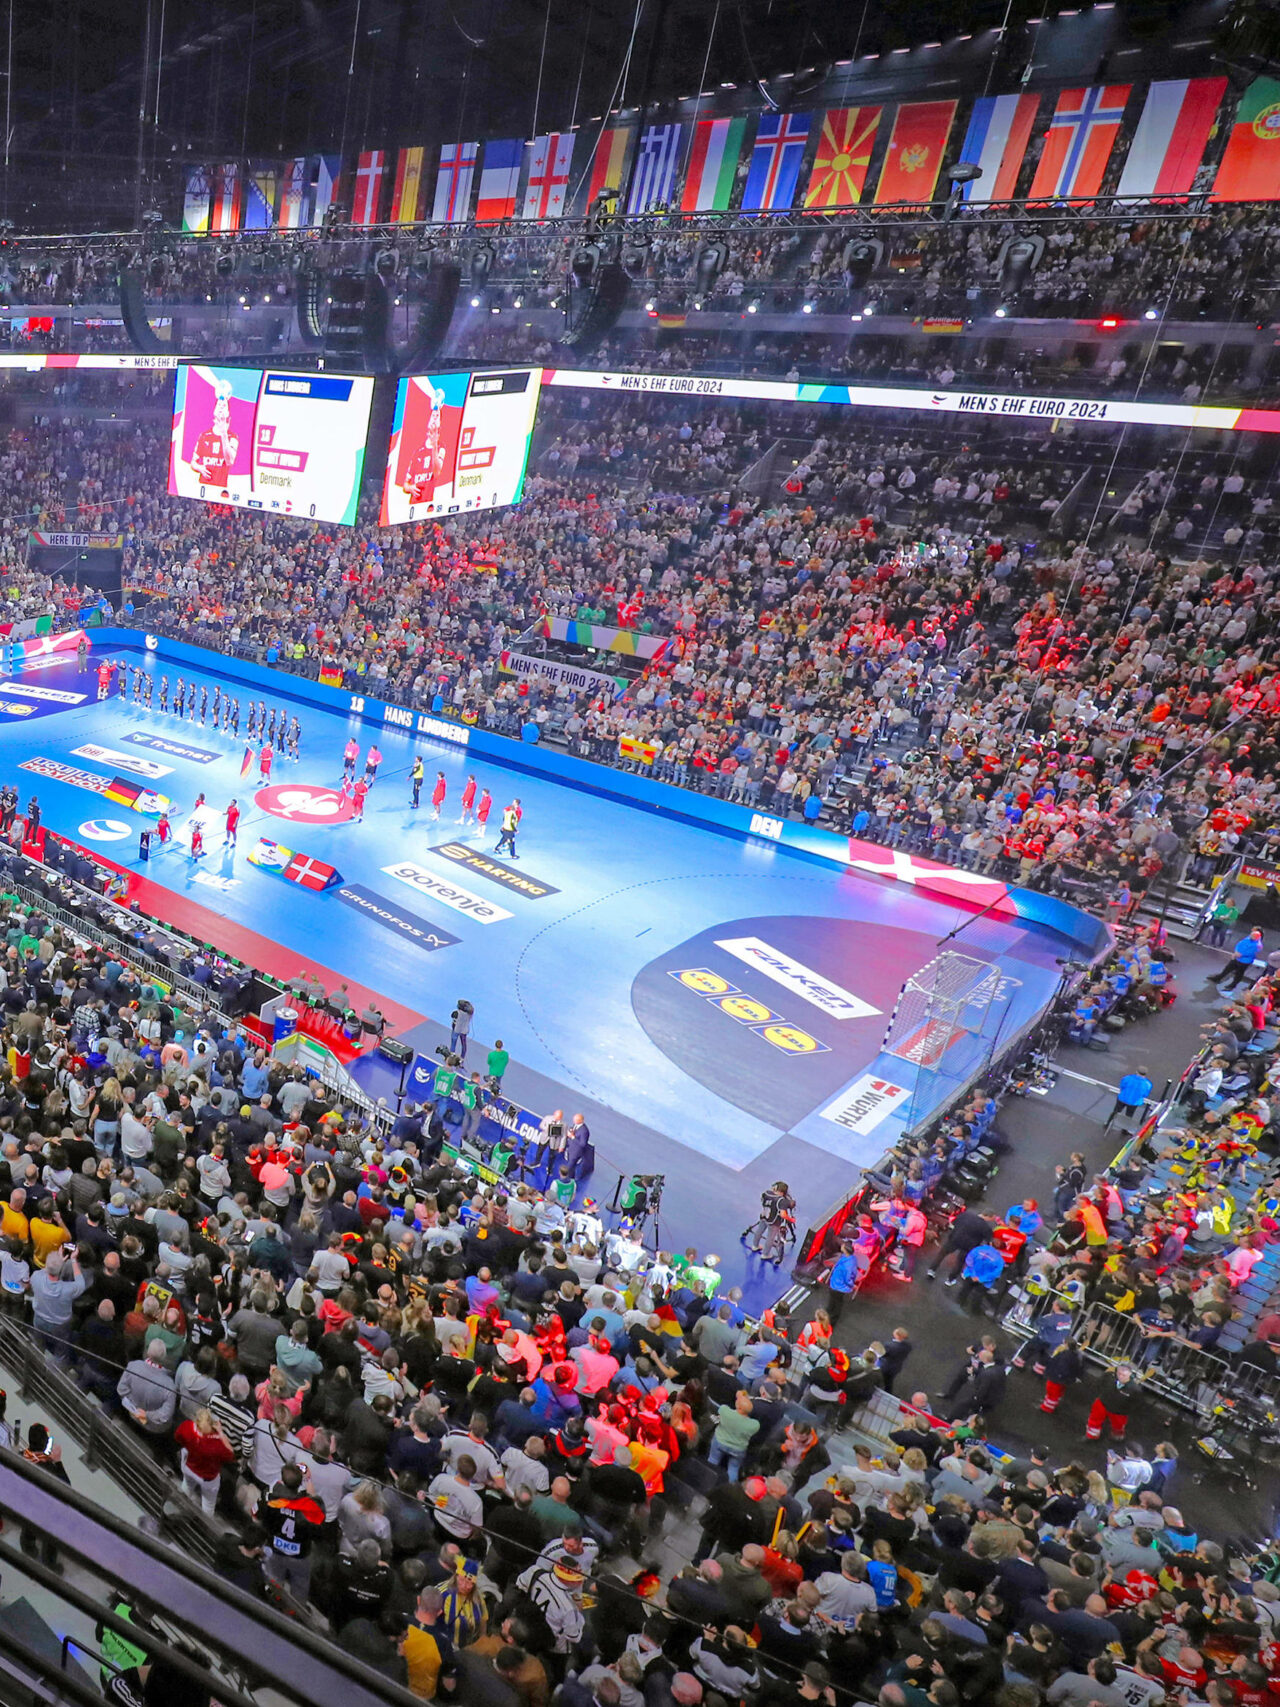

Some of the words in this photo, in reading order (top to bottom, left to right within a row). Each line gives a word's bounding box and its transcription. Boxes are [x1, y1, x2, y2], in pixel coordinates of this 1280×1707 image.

[157, 357, 170, 367] EHF
[650, 377, 667, 390] EHF
[669, 379, 694, 392] EURO
[696, 380, 723, 393] 2024
[1001, 398, 1026, 413] EHF
[1029, 400, 1065, 416] EURO
[1068, 402, 1108, 419] 2024
[260, 473, 293, 488] Denmark
[459, 473, 482, 487] Denmark
[49, 534, 68, 545] HERE
[72, 535, 80, 545] TO
[560, 670, 586, 687] EURO
[350, 695, 365, 713] 18
[384, 705, 413, 727] HANS
[418, 716, 470, 745] LINDBERG
[82, 746, 101, 756] DB
[150, 739, 214, 762] freenet
[26, 762, 64, 780] MOLY
[32, 757, 73, 776] LIQUI
[68, 775, 106, 794] MOLY
[76, 770, 113, 787] LIQU
[749, 813, 784, 839] DEN
[466, 857, 548, 896] HARTING
[1245, 867, 1264, 877] TSV
[394, 866, 495, 917] gorenje
[338, 888, 424, 937] GRUNDFOS
[745, 947, 855, 1009] FALKEN
[807, 991, 838, 1009] TYRES
[281, 1518, 296, 1540] 4
[275, 1539, 298, 1552] DKB
[885, 1576, 895, 1590] 10
[1124, 1689, 1145, 1706] 15
